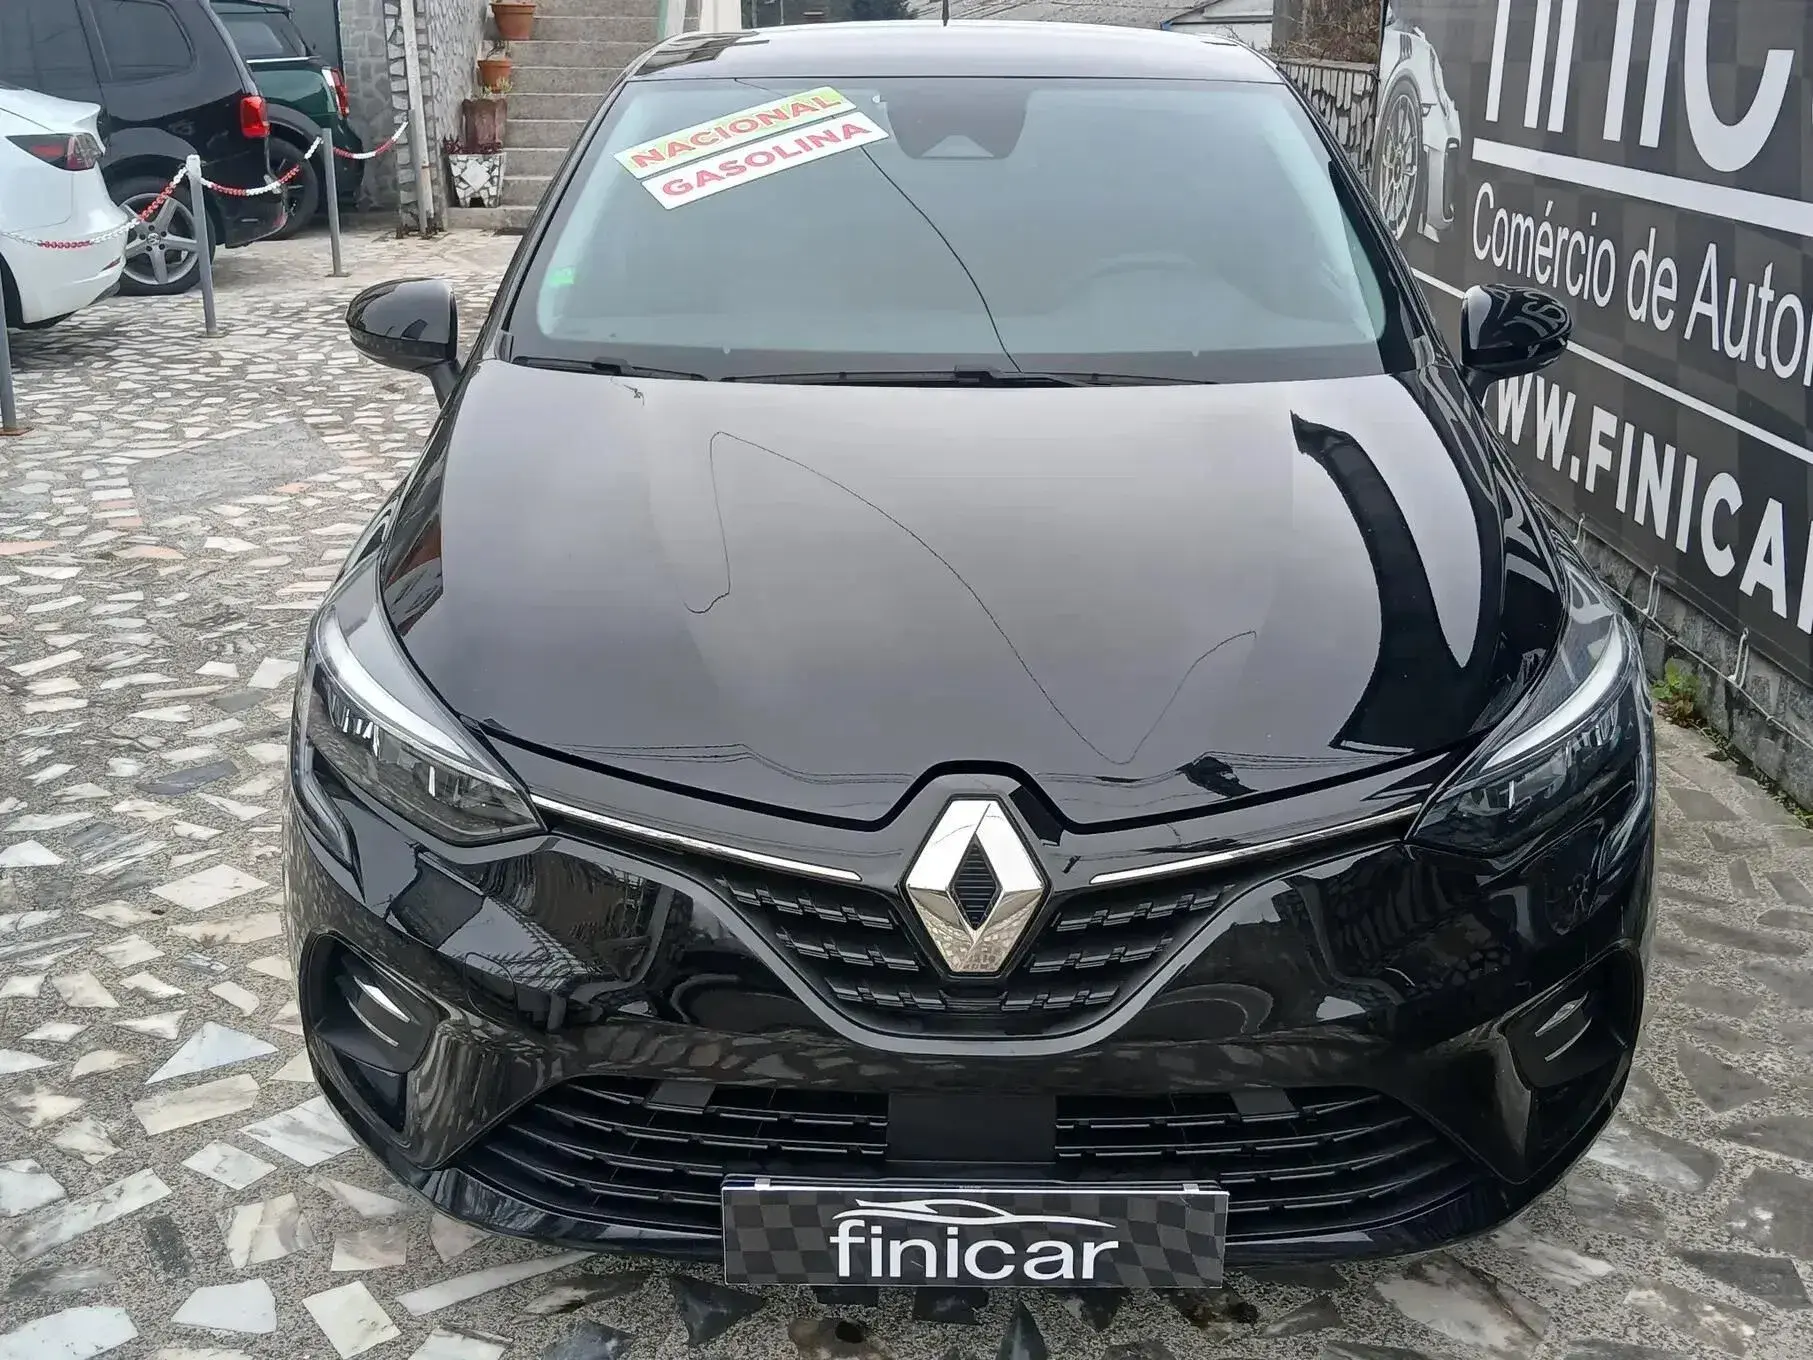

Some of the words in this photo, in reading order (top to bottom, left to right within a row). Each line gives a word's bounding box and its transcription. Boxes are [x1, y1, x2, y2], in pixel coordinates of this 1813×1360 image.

[630, 95, 841, 169] NACIONAL
[662, 122, 870, 196] GASOLINA
[1472, 182, 1616, 308] Comércio
[1627, 227, 1678, 331] de
[1683, 243, 1813, 387] Auto
[1482, 372, 1813, 635] WW.FINICA
[830, 1219, 1118, 1280] finicar
